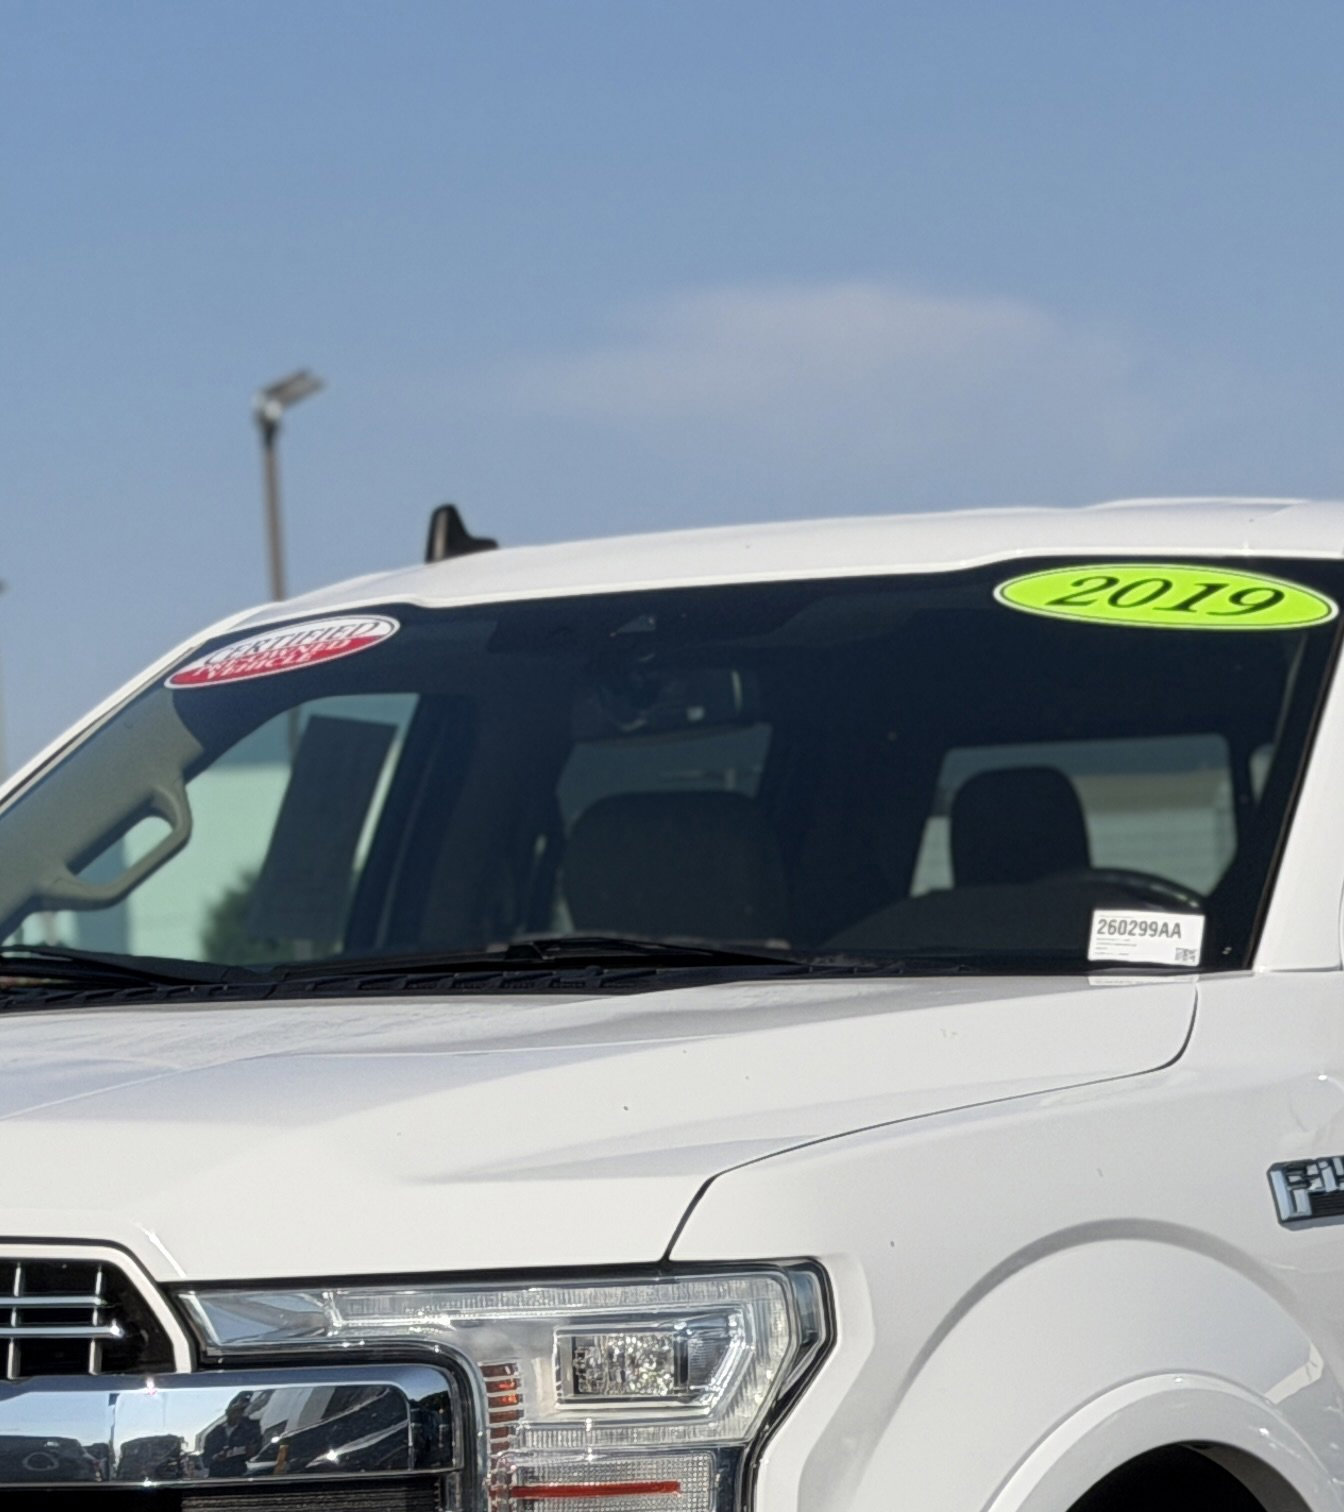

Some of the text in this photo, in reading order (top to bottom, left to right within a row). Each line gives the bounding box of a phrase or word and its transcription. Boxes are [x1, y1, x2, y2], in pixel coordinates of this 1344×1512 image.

[1045, 575, 1285, 616] 2019
[205, 621, 380, 665] CERTIFIED
[207, 653, 314, 680] VEHICLE
[1096, 918, 1182, 939] 260299AA
